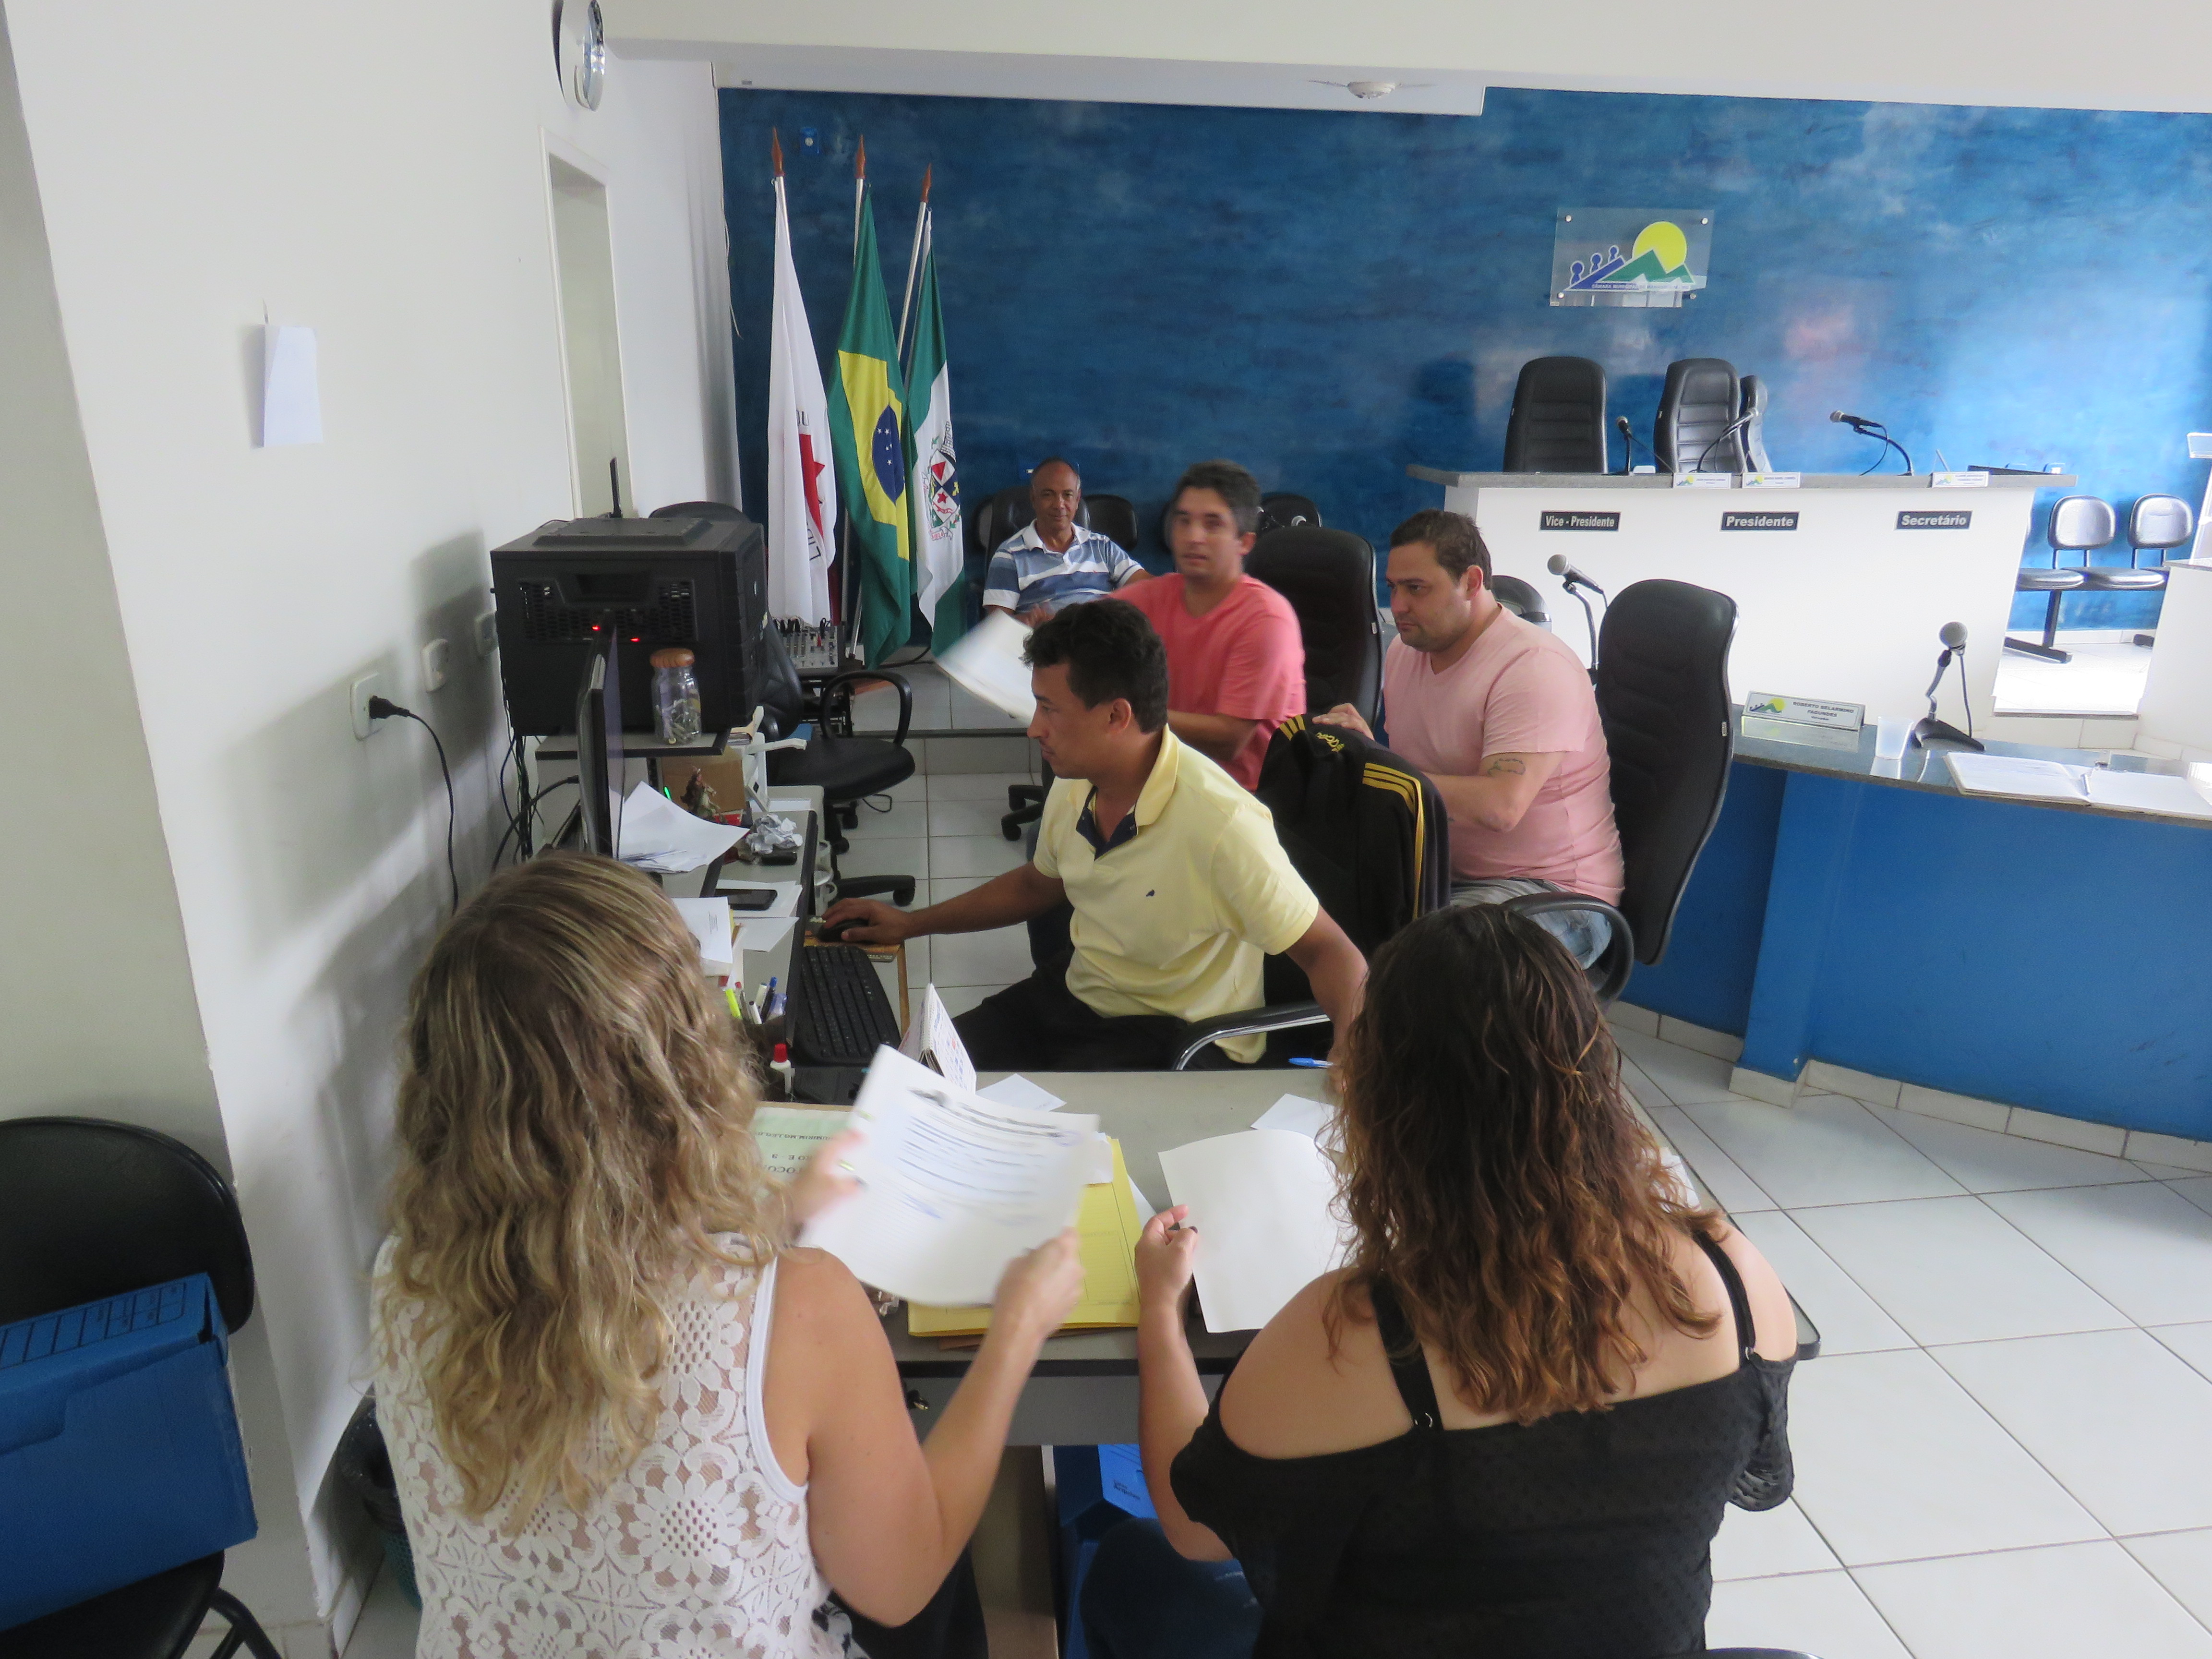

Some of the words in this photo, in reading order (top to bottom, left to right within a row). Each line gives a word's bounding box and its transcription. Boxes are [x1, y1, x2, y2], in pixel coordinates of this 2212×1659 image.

[1545, 515, 1564, 527] Vice
[1570, 515, 1615, 527] Presidente
[1726, 515, 1794, 527] Presidente
[1901, 514, 1967, 526] Secretário
